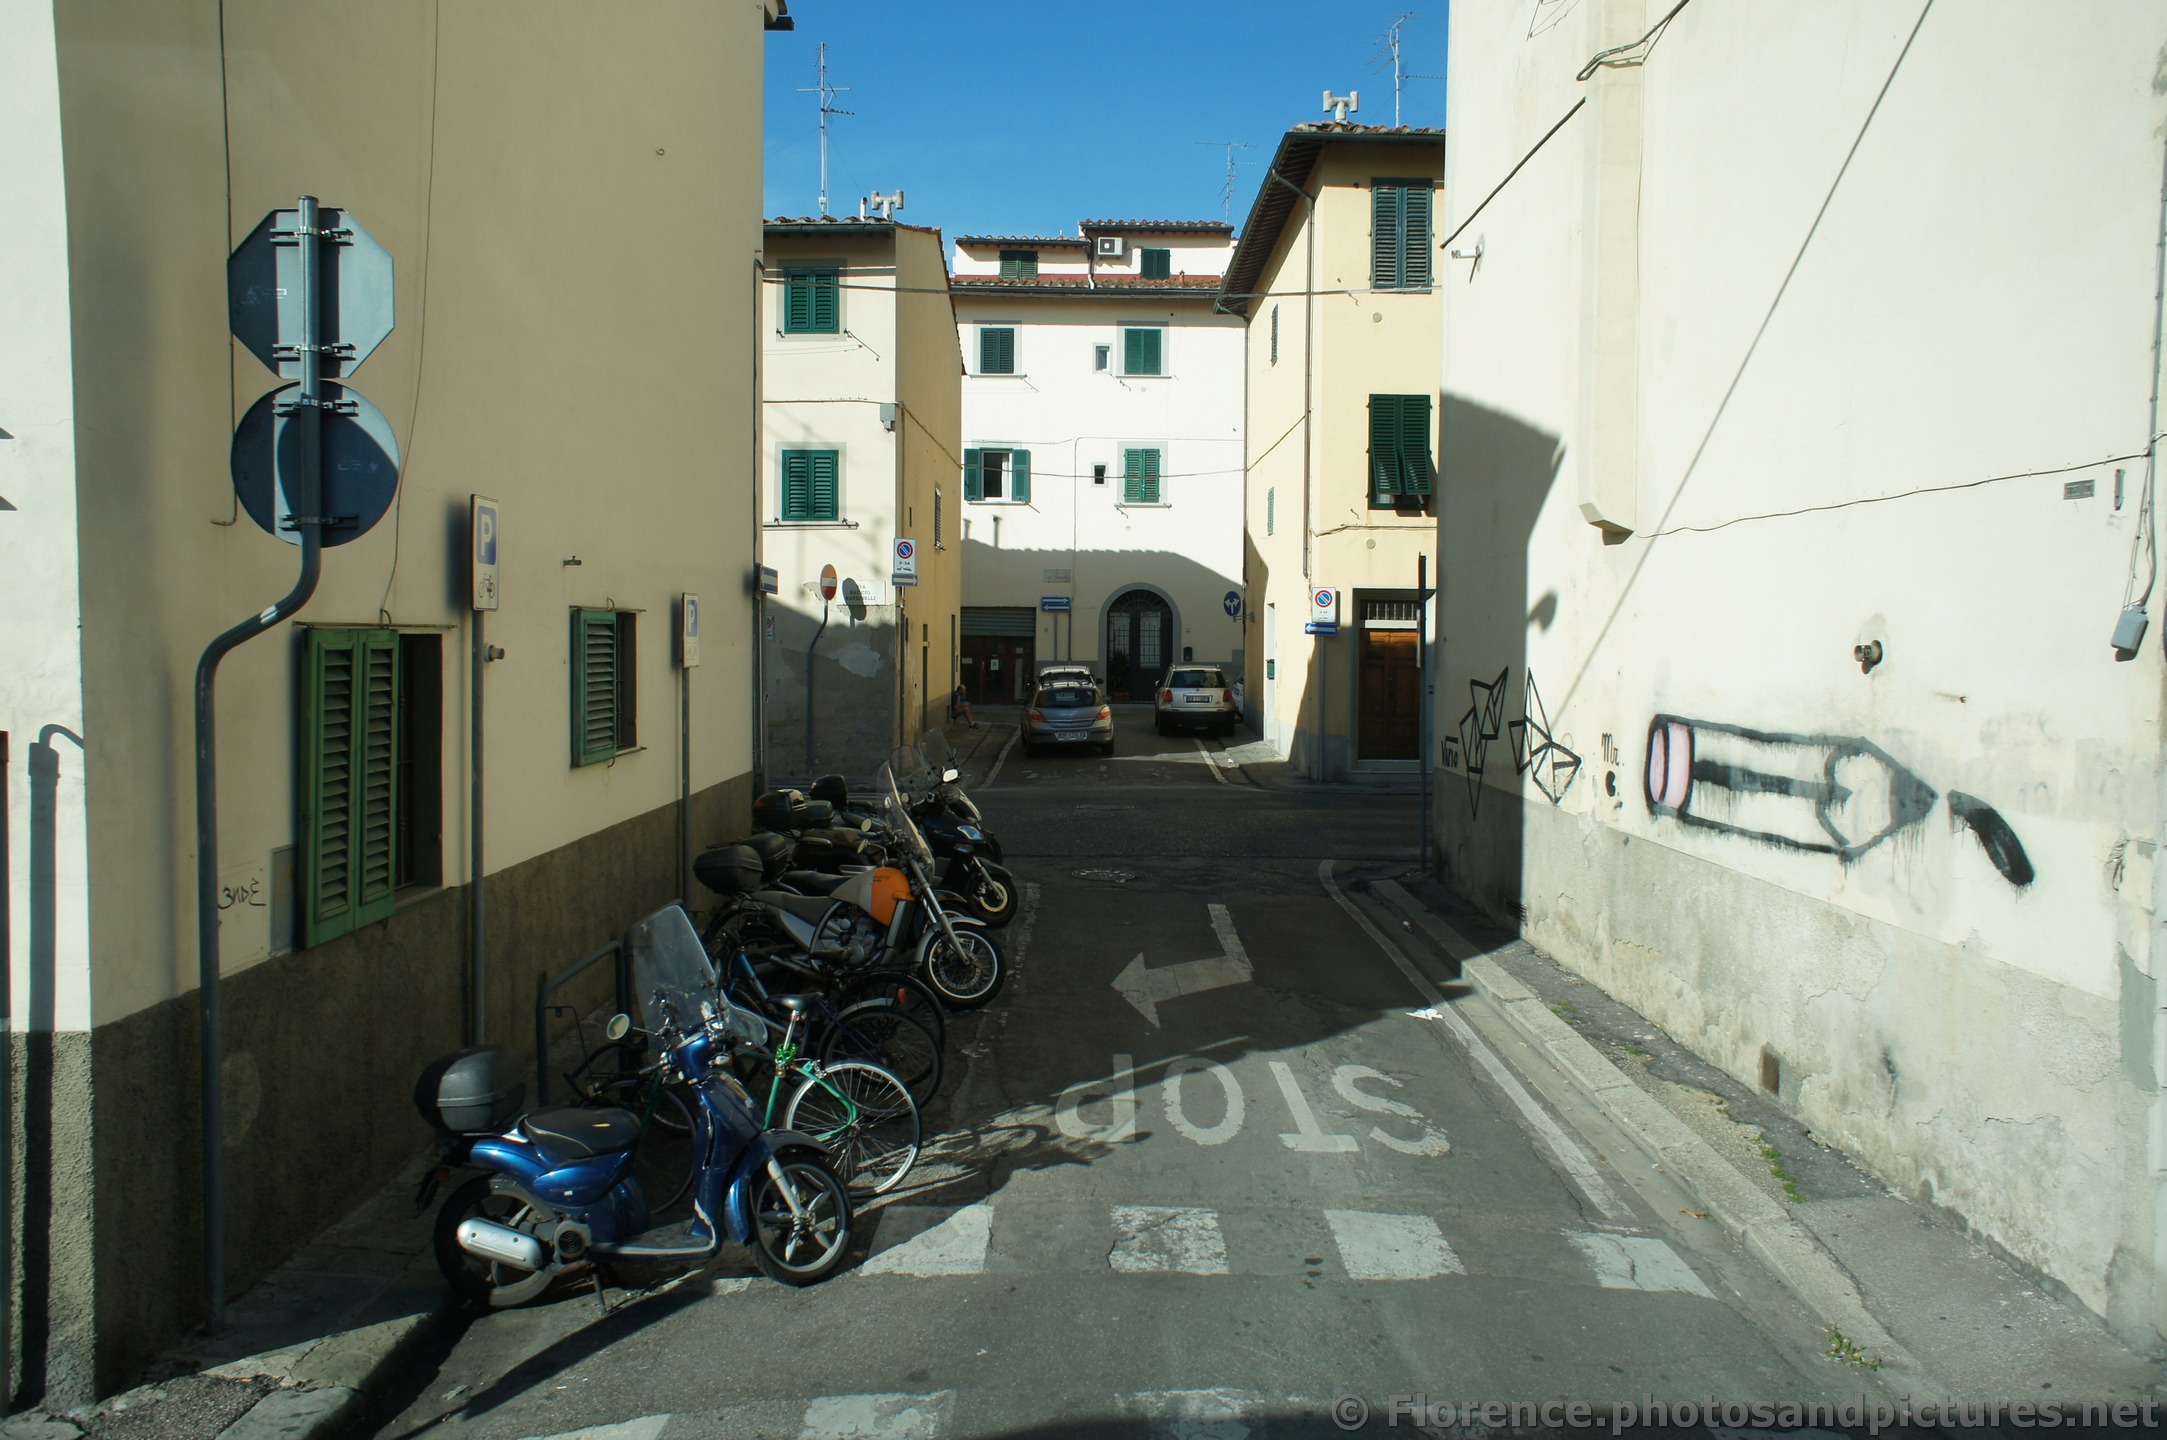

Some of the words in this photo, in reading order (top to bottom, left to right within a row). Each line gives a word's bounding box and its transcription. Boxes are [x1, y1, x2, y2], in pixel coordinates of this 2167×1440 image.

[480, 513, 493, 557] P
[688, 604, 696, 633] P
[1055, 1053, 1451, 1158] STOP
